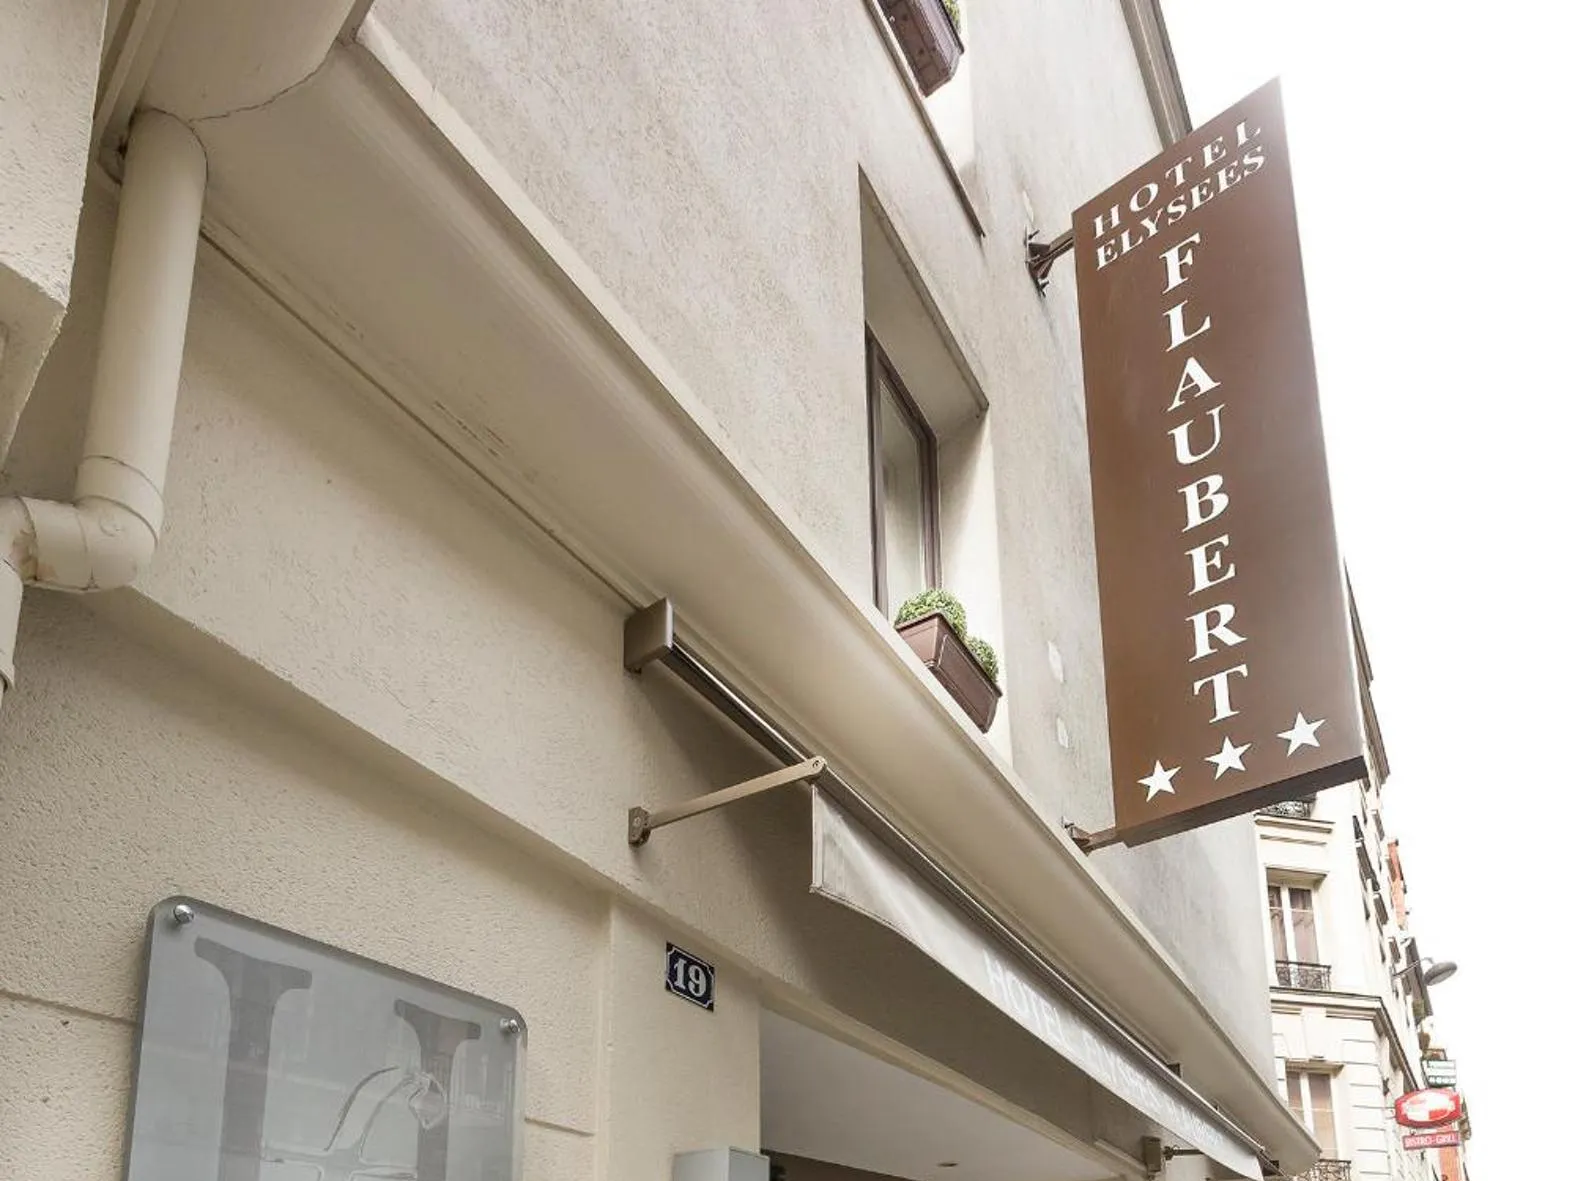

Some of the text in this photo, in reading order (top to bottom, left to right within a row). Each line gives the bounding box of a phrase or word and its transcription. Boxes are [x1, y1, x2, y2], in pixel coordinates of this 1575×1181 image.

[1093, 118, 1261, 240] HOTEL
[1096, 145, 1266, 271] ELYSEES
[1158, 232, 1249, 726] FLAUBERT
[673, 958, 707, 998] 19
